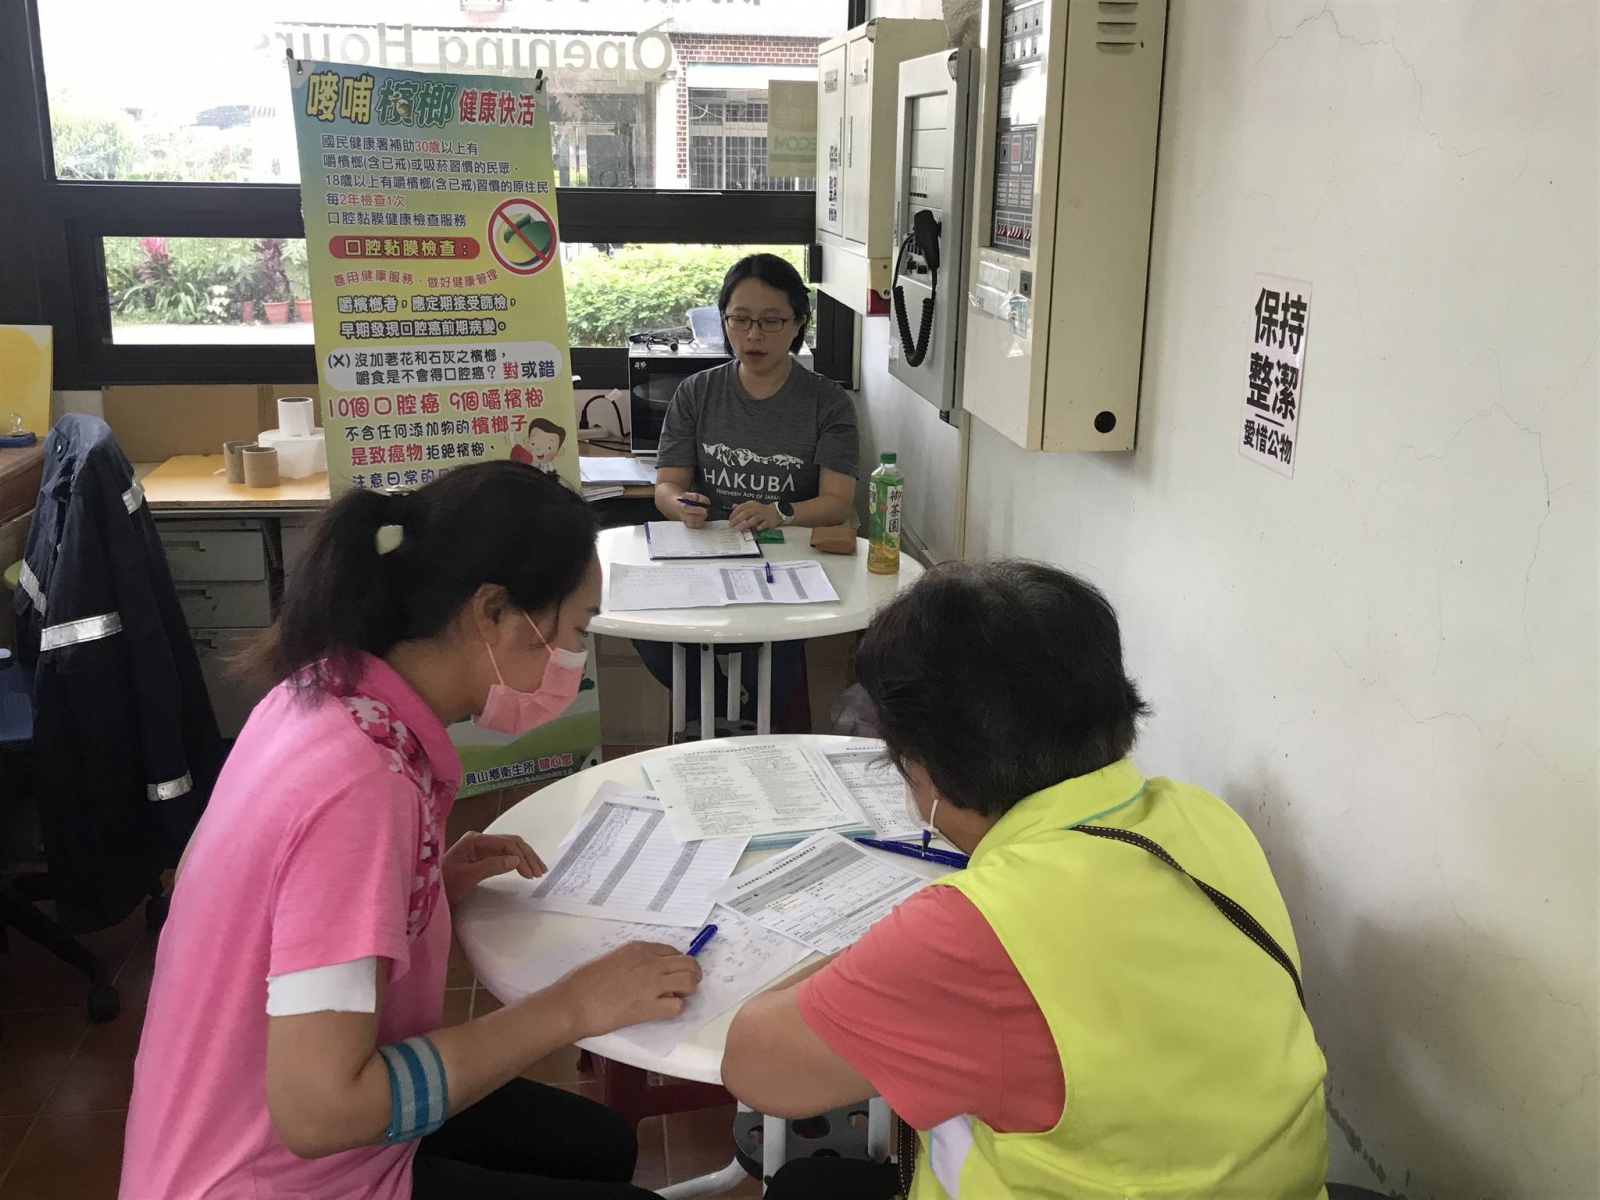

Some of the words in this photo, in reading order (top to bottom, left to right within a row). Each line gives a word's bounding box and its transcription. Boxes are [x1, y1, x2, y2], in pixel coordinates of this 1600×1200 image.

[459, 90, 536, 126] 健康快活
[321, 134, 478, 156] 國民健康署補助30歲以上有
[325, 173, 549, 193] 18歲以上有嚼檳榔(含已戒)習慣的原住民
[326, 193, 406, 208] 每2年檢查1次
[327, 211, 467, 227] 口腔黏膜健康檢查服務
[1254, 286, 1308, 354] 保持
[503, 360, 555, 379] 對或錯
[1246, 351, 1300, 422] 整潔
[345, 414, 528, 442] 不含任何添加物的檳榔子
[1243, 419, 1293, 465] 愛惜公物
[703, 467, 795, 493] HAKUBA
[889, 489, 902, 533] 御茶園
[465, 760, 535, 788] 員山鄉衛生所
